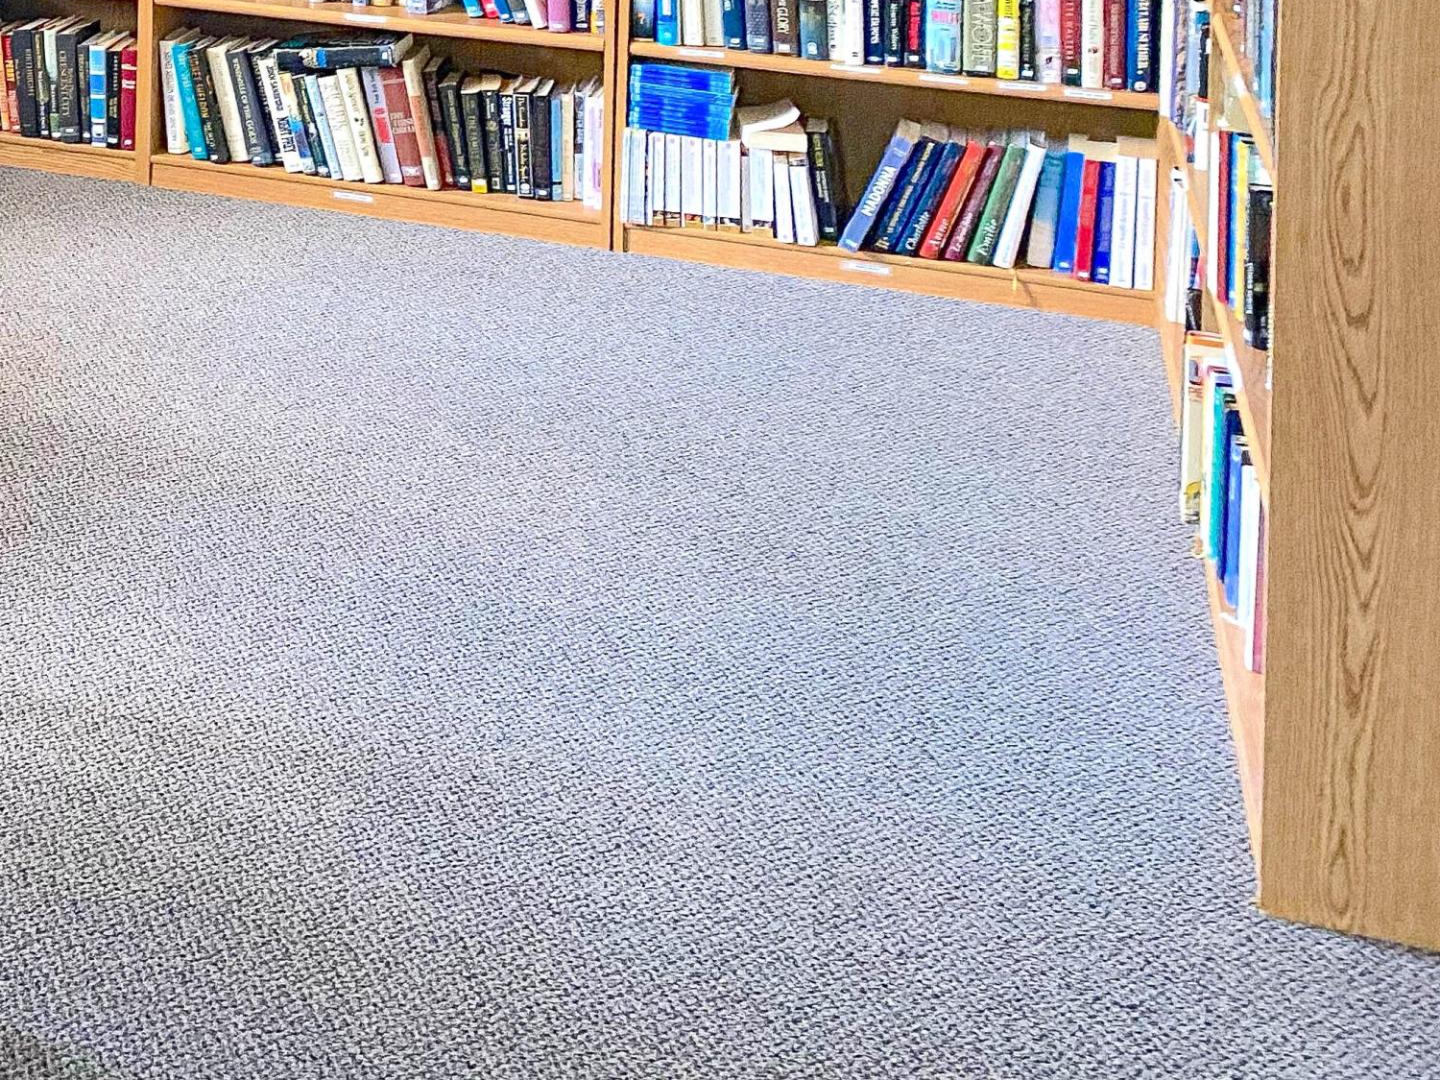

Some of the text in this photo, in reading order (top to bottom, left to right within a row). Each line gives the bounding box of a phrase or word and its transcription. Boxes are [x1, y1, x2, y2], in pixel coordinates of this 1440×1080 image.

[777, 6, 791, 35] GLORY
[971, 11, 994, 63] WOLFE
[861, 165, 898, 217] MADONNA
